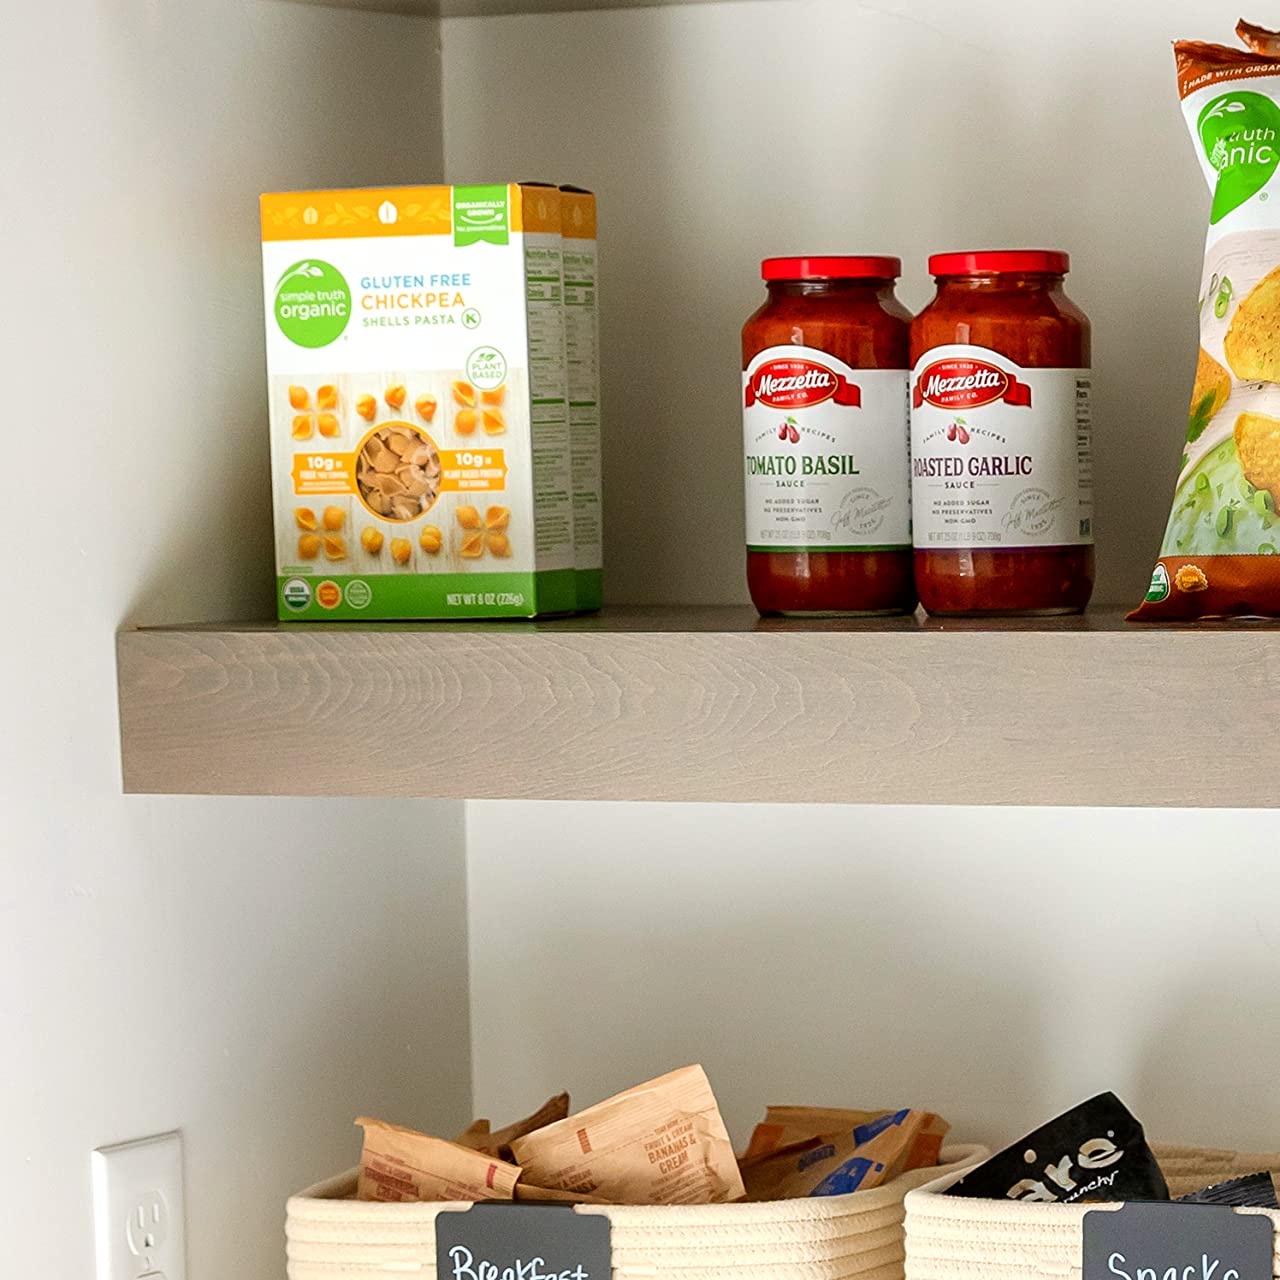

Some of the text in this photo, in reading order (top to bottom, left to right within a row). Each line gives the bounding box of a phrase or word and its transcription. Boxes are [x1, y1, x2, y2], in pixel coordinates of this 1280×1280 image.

[1216, 68, 1242, 78] WITH
[360, 273, 472, 290] GLUTEN FREE
[280, 289, 346, 303] simple truth
[361, 292, 466, 310] CHICKPEA
[280, 301, 347, 321] organic
[362, 316, 411, 327] SHELLS
[415, 314, 456, 326] PASTA
[471, 362, 502, 370] PLANT
[472, 370, 503, 379] BASED
[755, 369, 831, 397] Mezzetta
[923, 369, 1000, 398] Mezzetta
[772, 394, 795, 403] FAMILY
[941, 394, 965, 403] FAMILY
[801, 427, 837, 443] RECIPES
[970, 427, 1006, 444] RECIPES
[307, 456, 334, 471] 10g
[455, 453, 483, 467] 10g
[746, 455, 860, 475] TOMATO BASIL
[968, 456, 1033, 476] GARLIC
[776, 480, 805, 488] SAUCE
[945, 481, 975, 489] SAUCE
[648, 1133, 697, 1164] BANANAS &
[659, 1150, 689, 1174] CREAM
